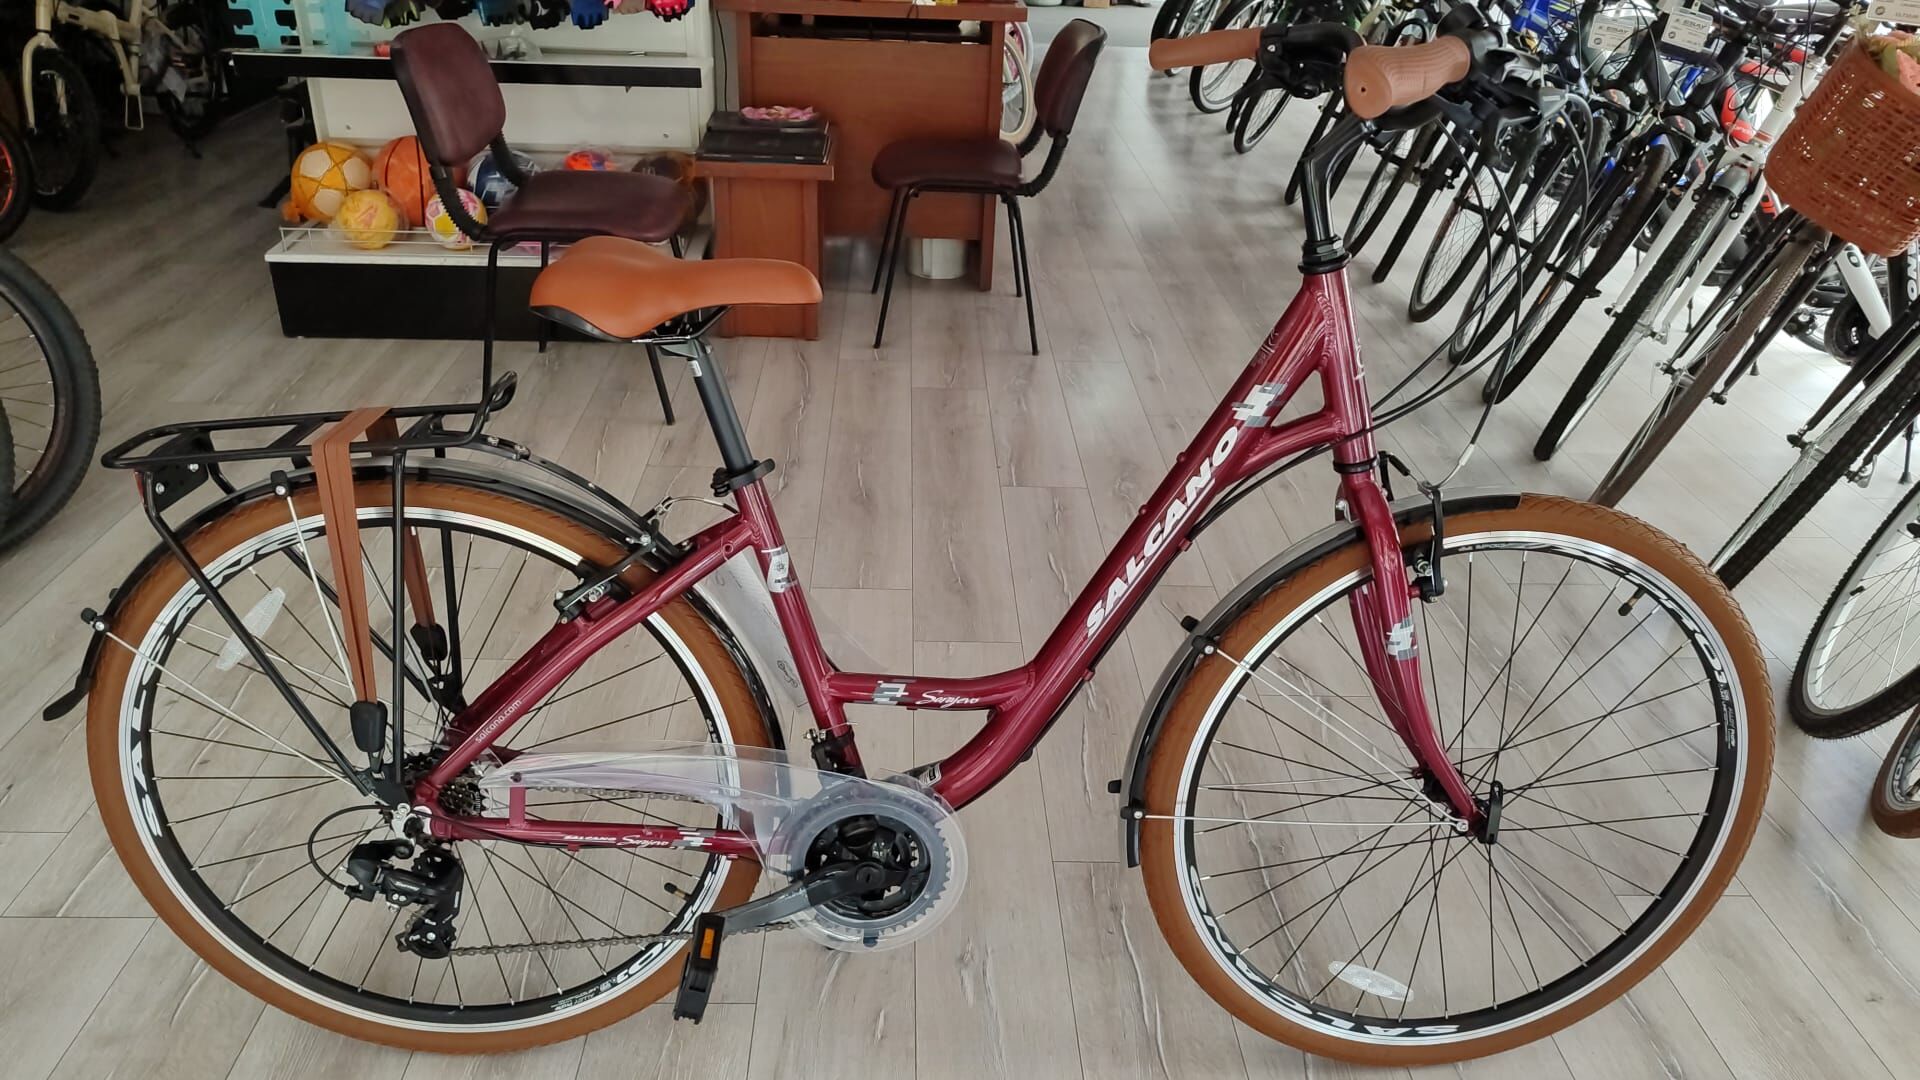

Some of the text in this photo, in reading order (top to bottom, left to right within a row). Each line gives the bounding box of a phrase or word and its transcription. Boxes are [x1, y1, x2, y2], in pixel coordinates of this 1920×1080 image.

[1086, 428, 1242, 637] SALCANO
[474, 698, 524, 744] salcano.com
[915, 689, 980, 709] Sarajevo
[616, 834, 671, 849] Sarajevo
[1190, 864, 1461, 1038] SALCANO
